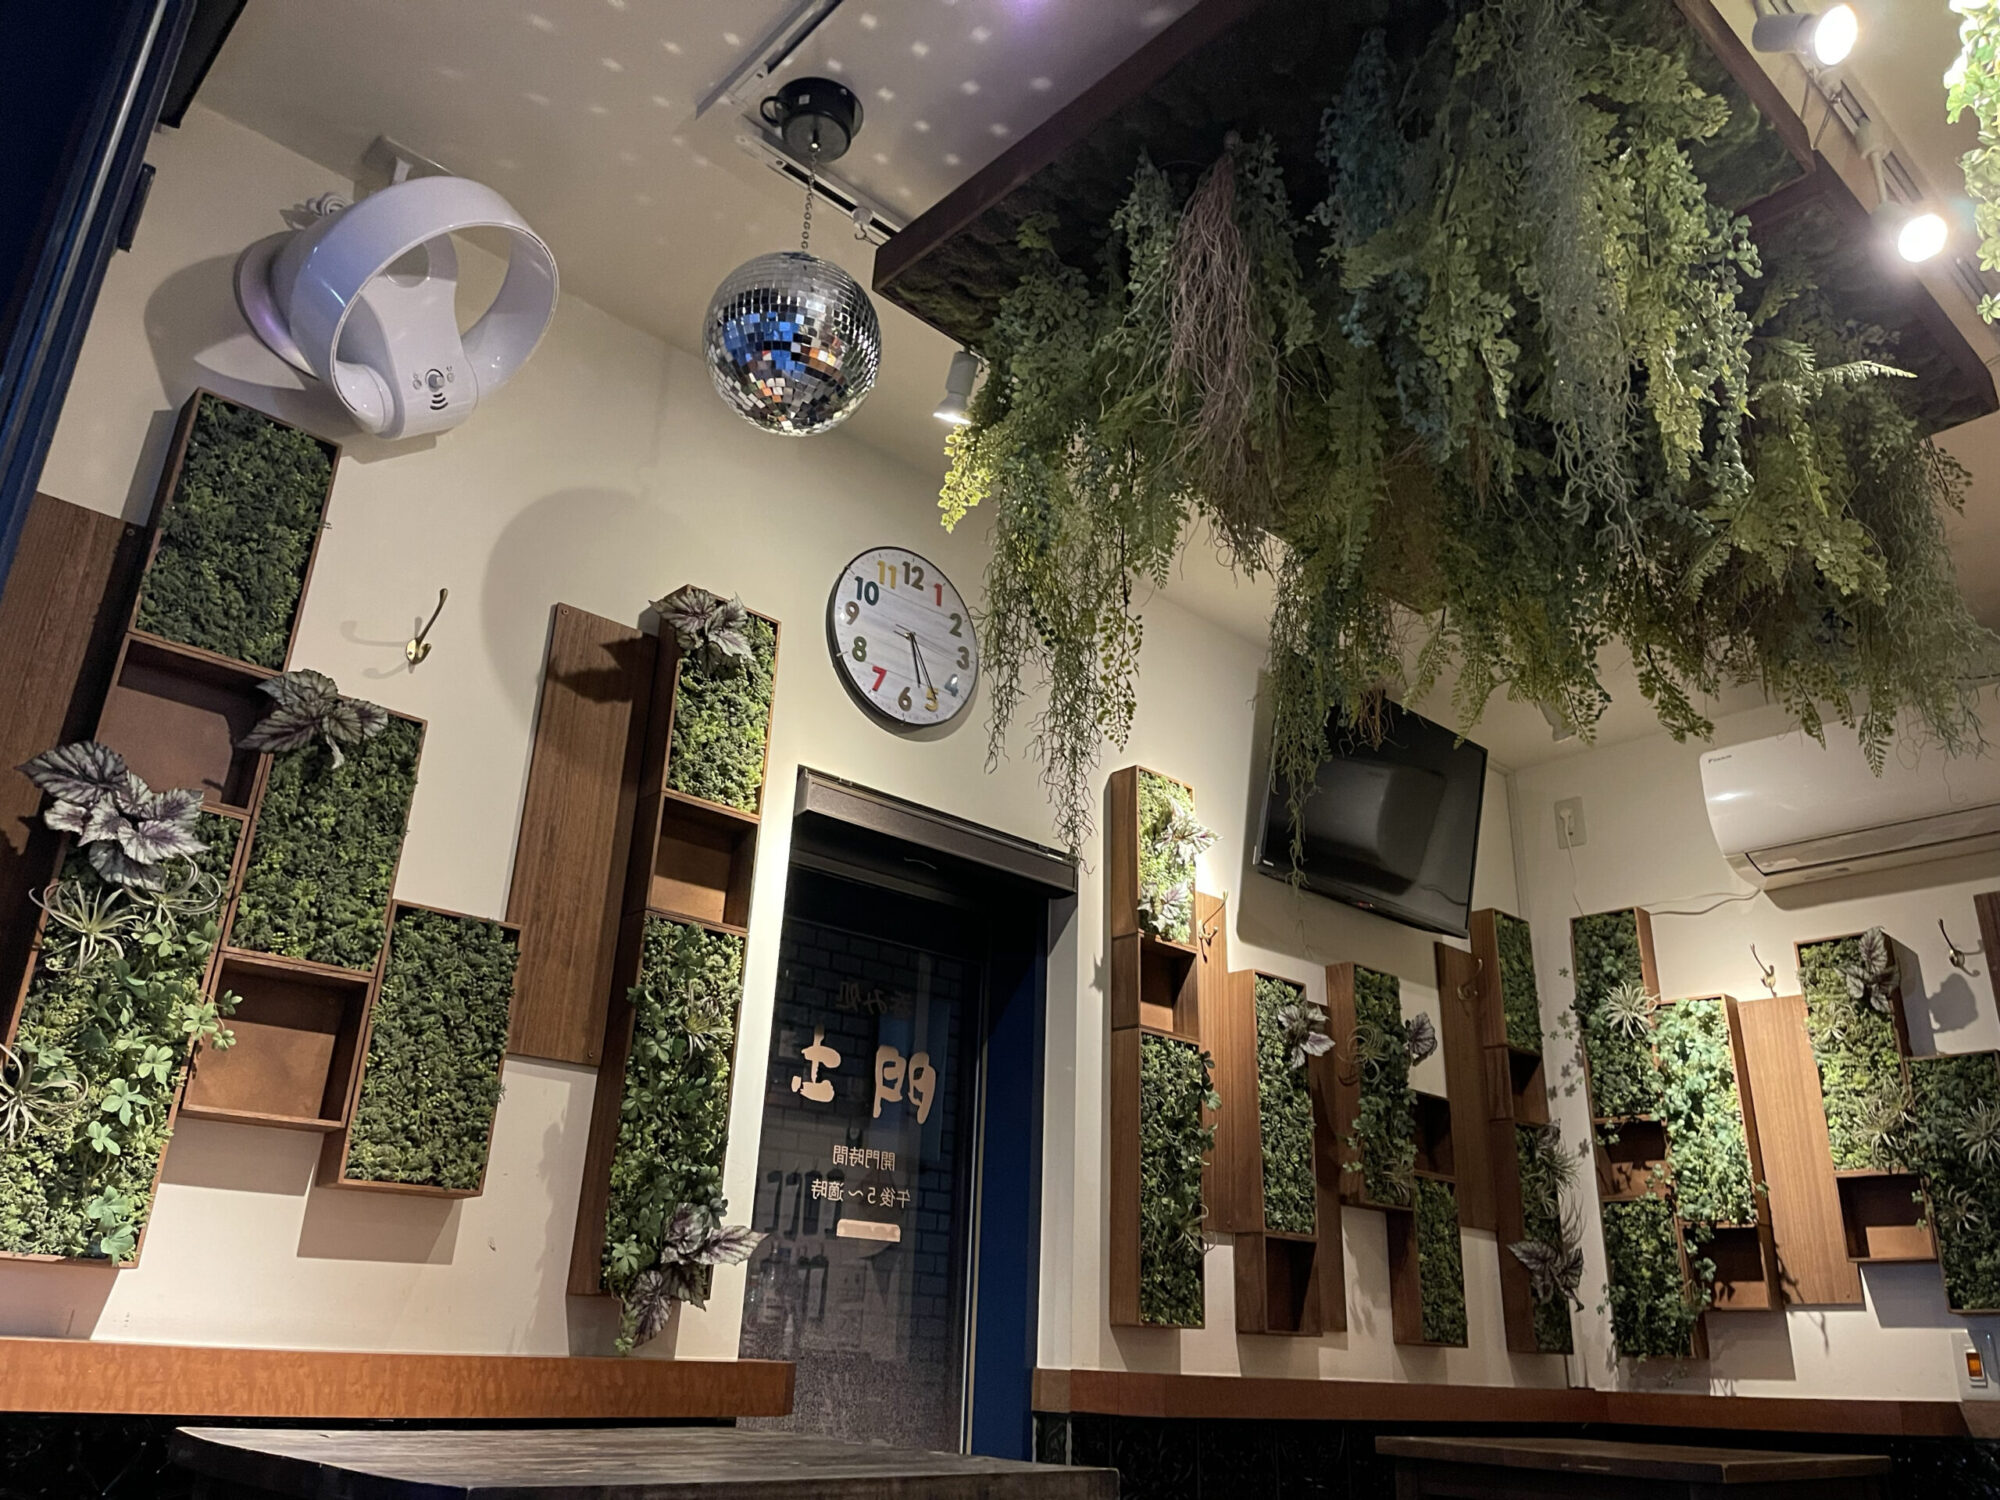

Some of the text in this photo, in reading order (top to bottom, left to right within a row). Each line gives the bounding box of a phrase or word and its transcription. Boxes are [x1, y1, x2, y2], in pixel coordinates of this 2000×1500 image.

[877, 560, 896, 589] 11
[902, 561, 925, 591] 12
[855, 576, 879, 606] 10
[934, 583, 943, 607] 1
[845, 601, 860, 625] 9
[949, 613, 962, 637] 2
[852, 636, 867, 662] 8
[956, 646, 970, 670] 3
[872, 666, 887, 692] 7
[944, 674, 959, 697] 4
[898, 687, 912, 711] 6
[924, 687, 939, 712] 5
